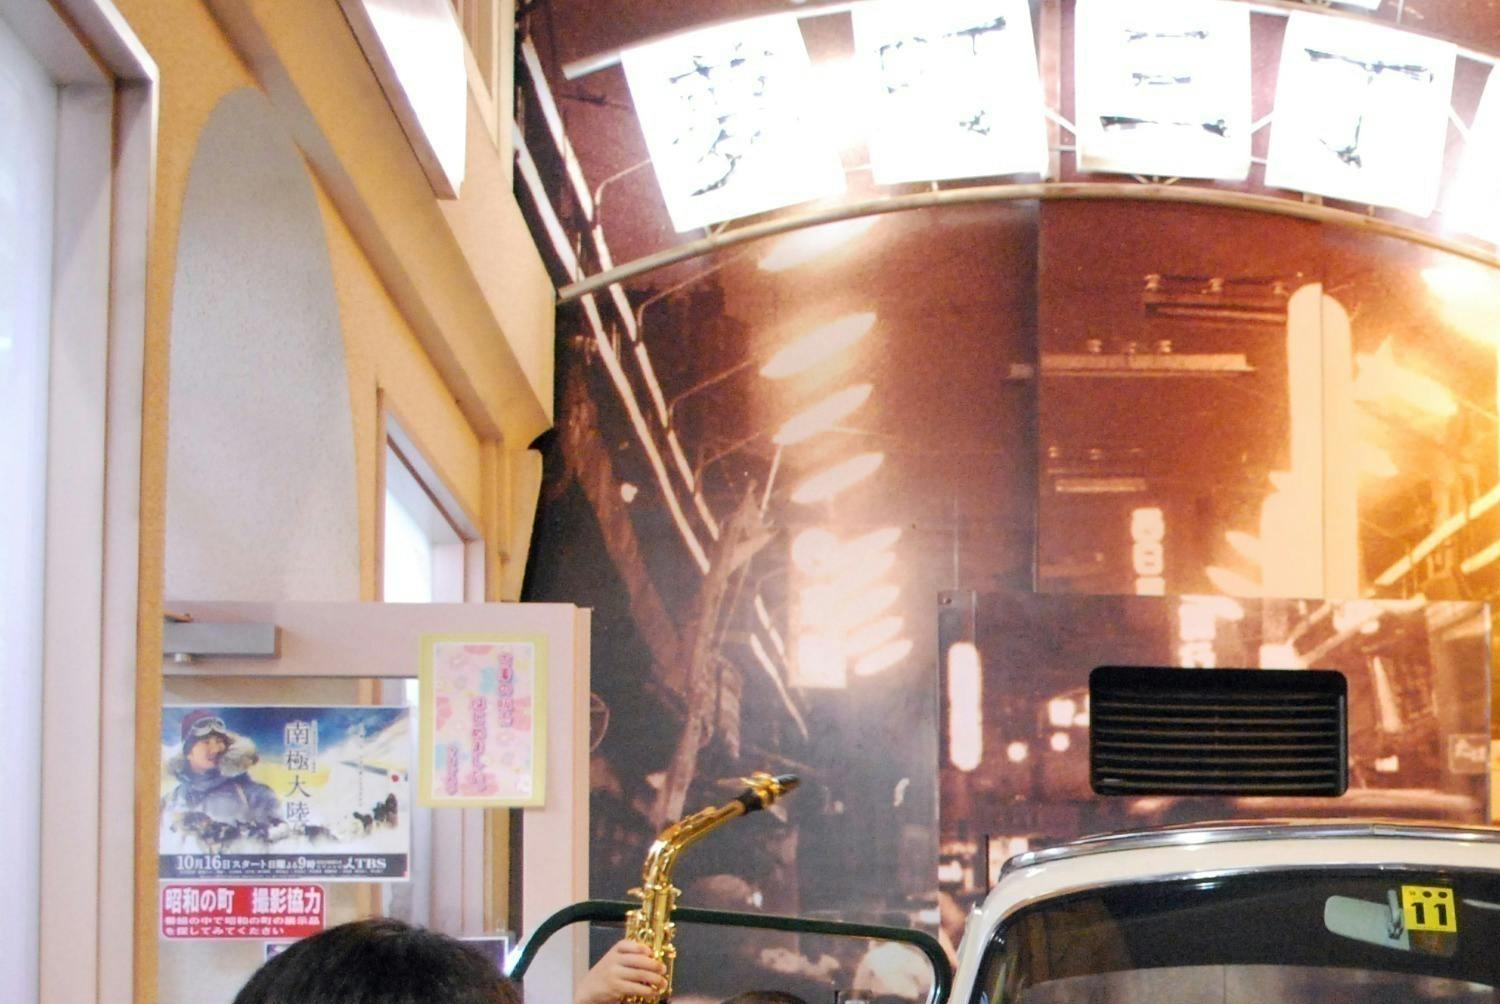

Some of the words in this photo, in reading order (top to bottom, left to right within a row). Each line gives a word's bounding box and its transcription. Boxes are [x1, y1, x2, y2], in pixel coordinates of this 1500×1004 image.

[285, 721, 311, 821] 南極大陸
[354, 857, 387, 869] TBS
[165, 887, 235, 914] 昭和の町
[252, 887, 321, 914] 撮影協力
[1411, 902, 1448, 926] 11
